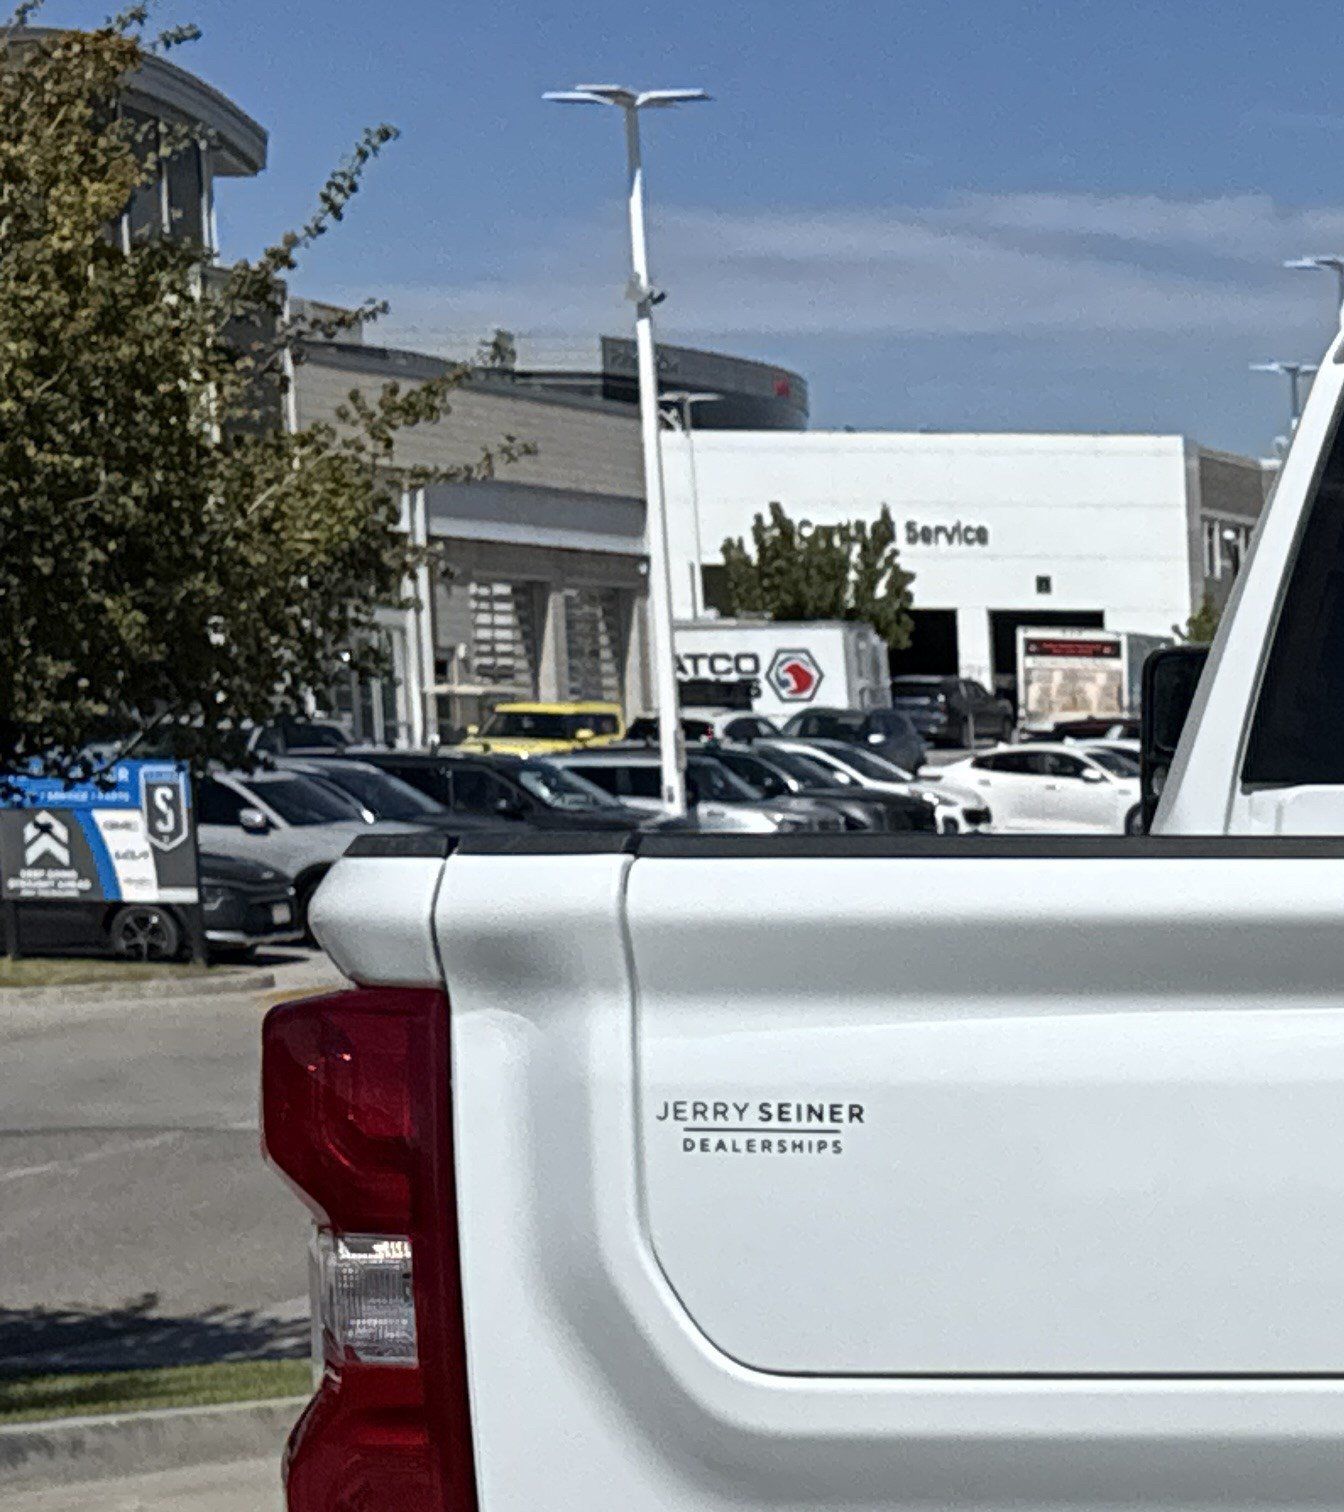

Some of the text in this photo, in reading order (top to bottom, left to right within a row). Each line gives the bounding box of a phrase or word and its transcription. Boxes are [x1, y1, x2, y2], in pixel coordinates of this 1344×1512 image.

[905, 519, 988, 546] Service
[674, 652, 760, 676] ATCO
[656, 1101, 865, 1124] JERRY SEINER
[682, 1137, 844, 1154] DEALERSHIPS
